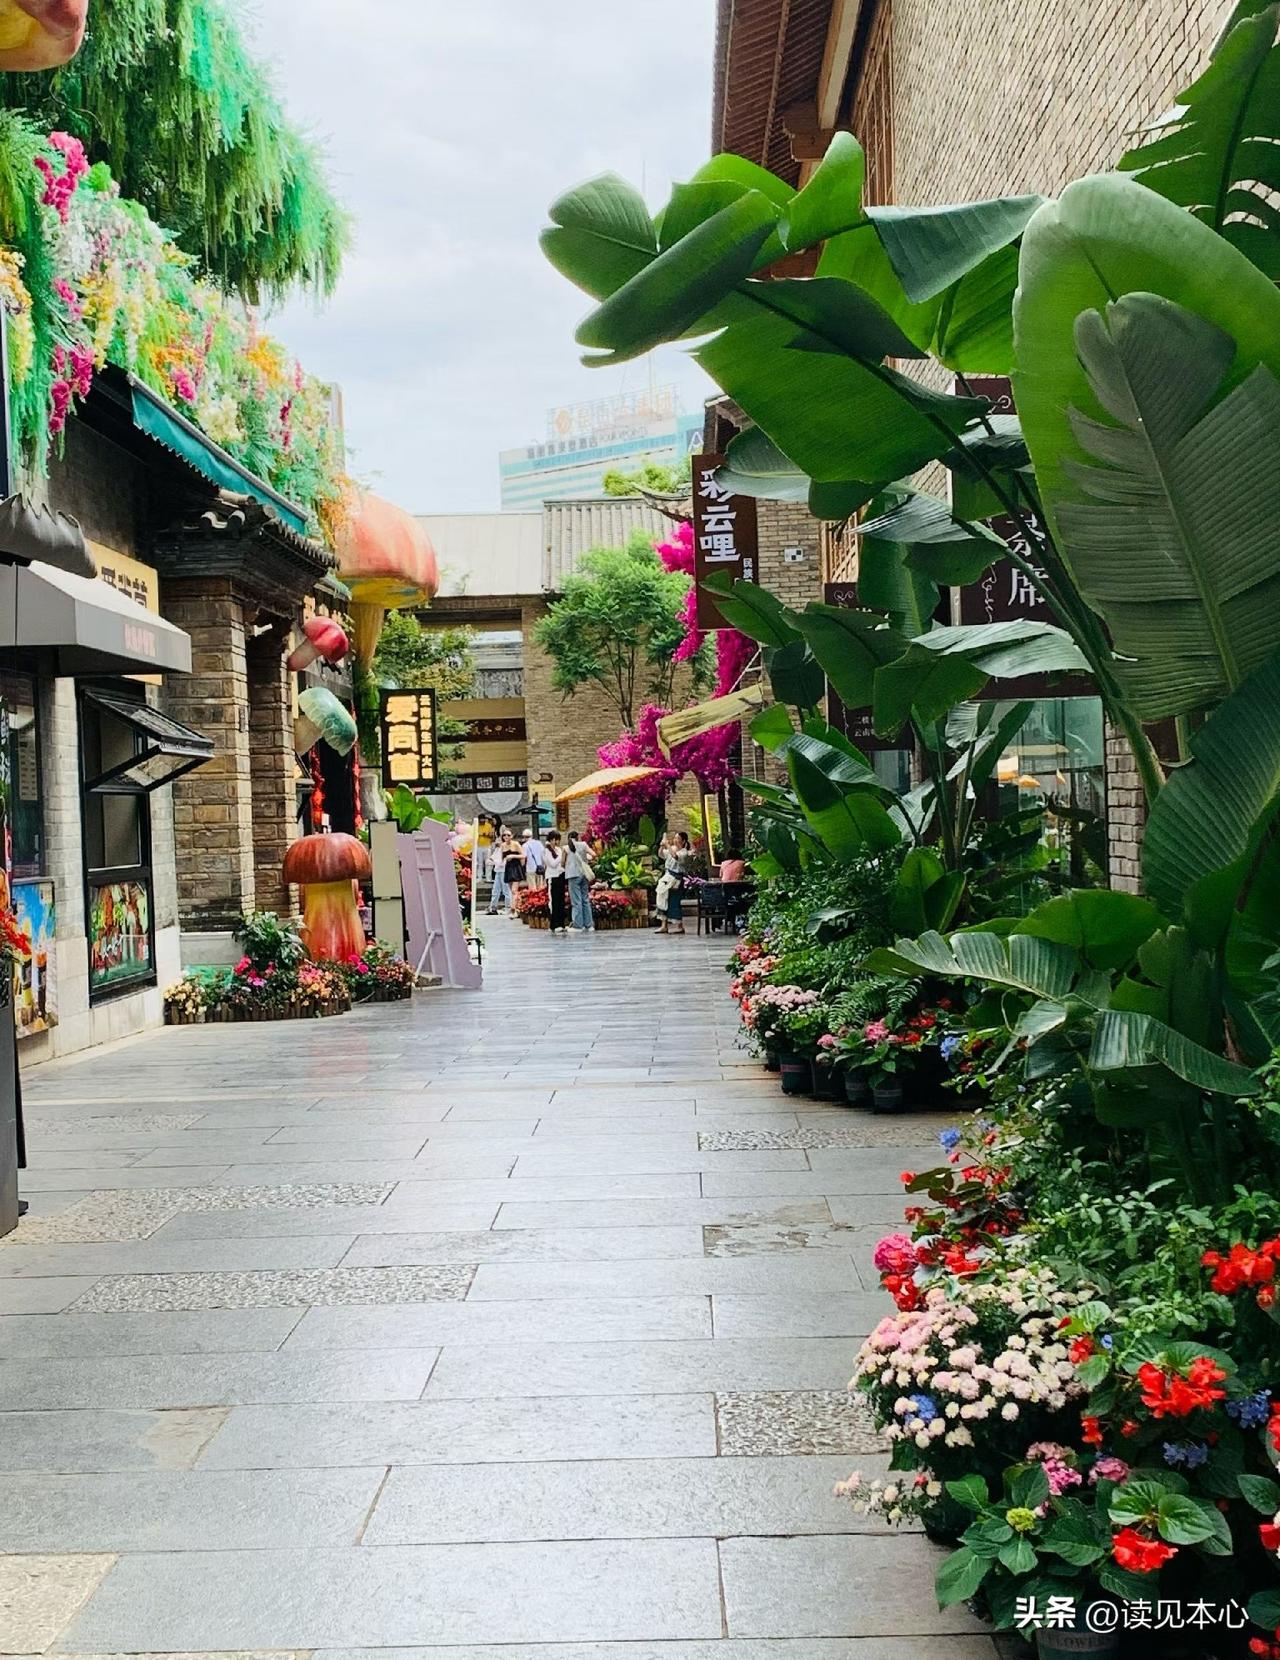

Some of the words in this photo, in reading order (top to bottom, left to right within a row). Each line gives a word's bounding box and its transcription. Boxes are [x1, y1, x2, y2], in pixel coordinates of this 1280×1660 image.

[698, 465, 740, 562] 彩云哩
[743, 557, 754, 583] 民族
